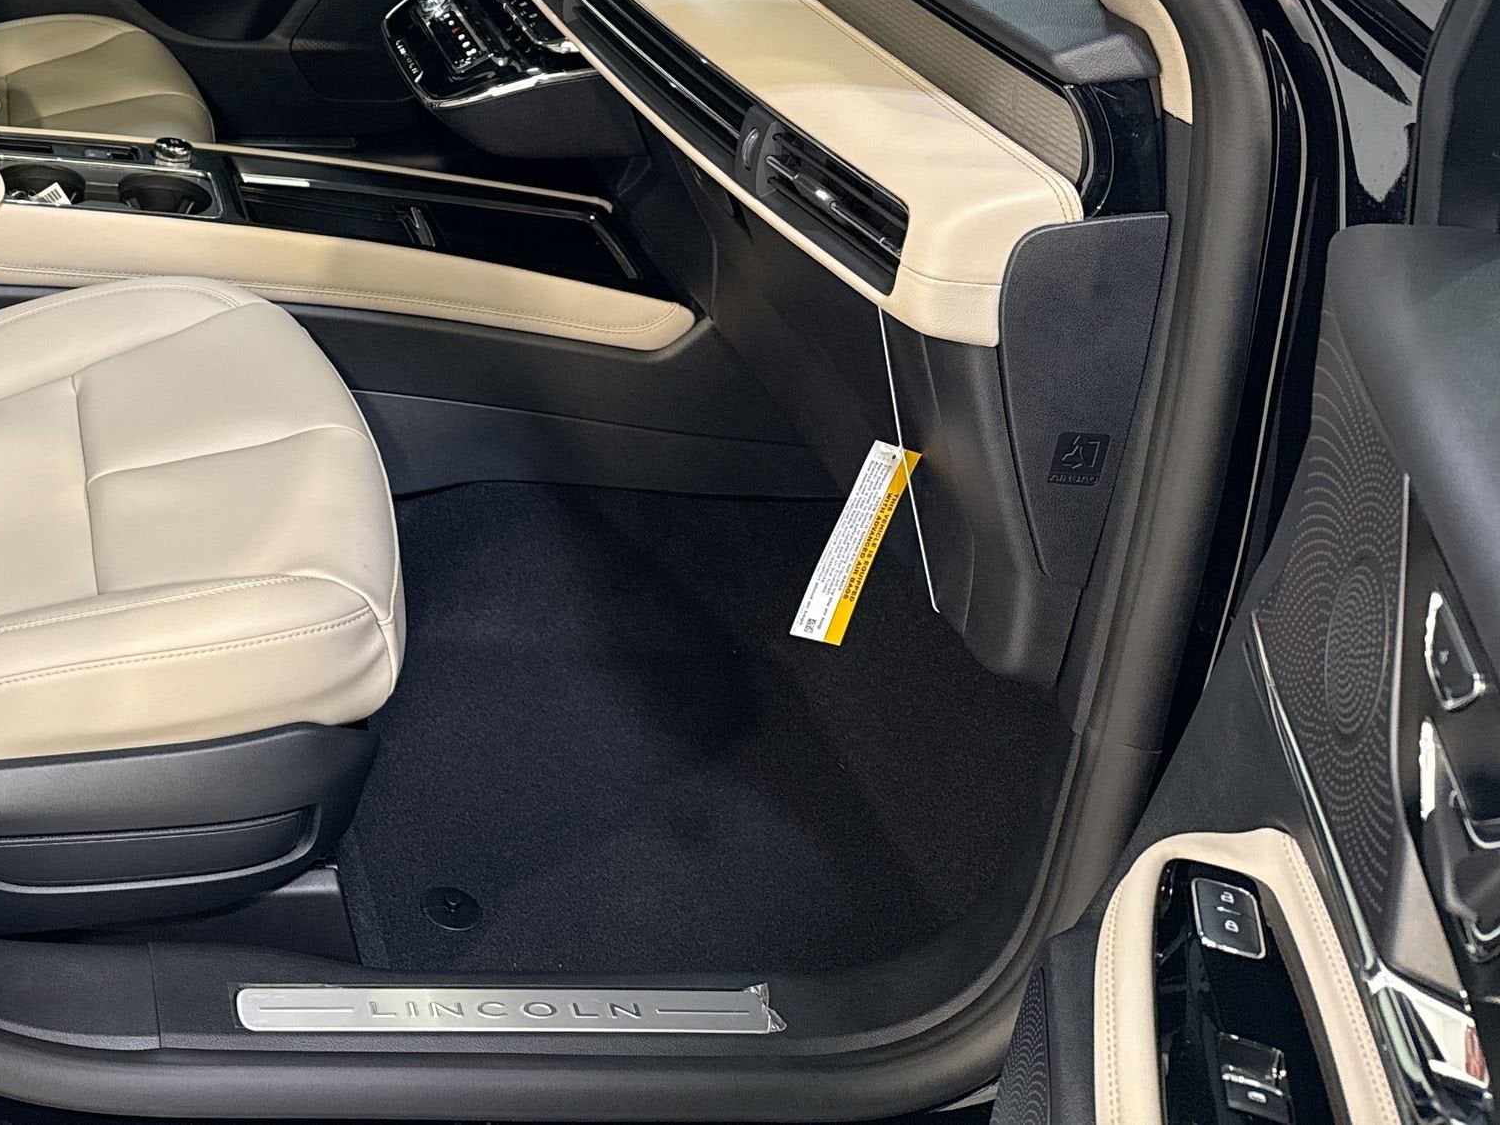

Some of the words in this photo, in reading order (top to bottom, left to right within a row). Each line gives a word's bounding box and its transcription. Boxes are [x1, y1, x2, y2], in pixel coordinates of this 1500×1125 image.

[879, 491, 893, 514] WITH
[886, 491, 900, 512] THIS
[858, 514, 882, 559] ADVANCED
[870, 513, 890, 548] VEHICLE
[841, 576, 856, 600] BAGS
[847, 559, 870, 602] EQUIPPED
[368, 1000, 643, 1021] LINCOLN
